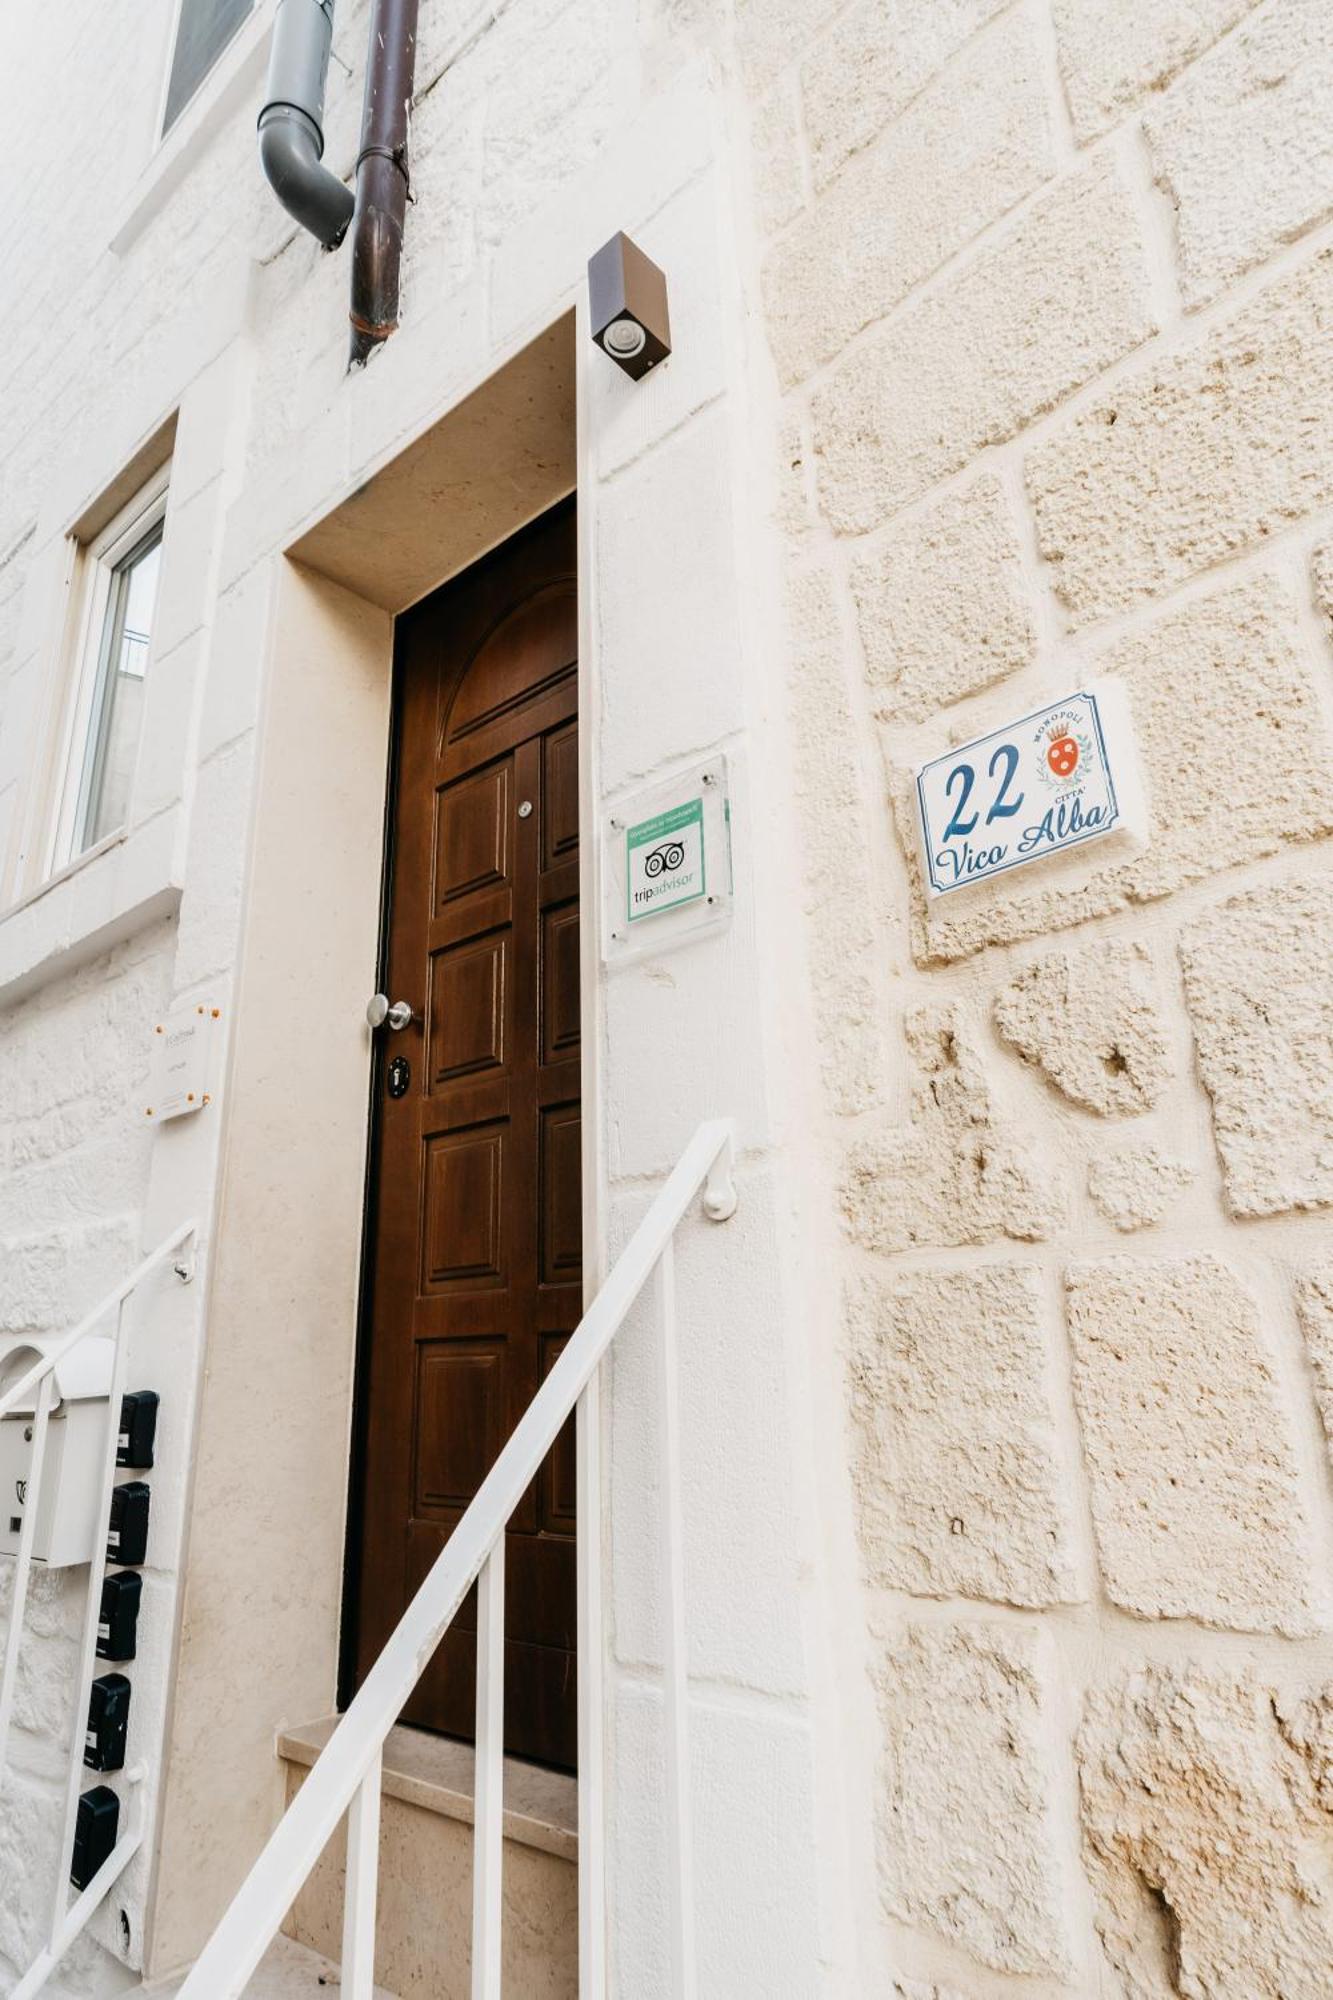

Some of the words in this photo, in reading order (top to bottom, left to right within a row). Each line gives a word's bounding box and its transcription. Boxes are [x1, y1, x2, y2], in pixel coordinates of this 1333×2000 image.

[1033, 710, 1084, 743] MONOPOLI
[942, 744, 1025, 843] 22
[936, 841, 1008, 880] Vico
[1018, 798, 1107, 853] Alba
[634, 873, 694, 903] tripadvisor
